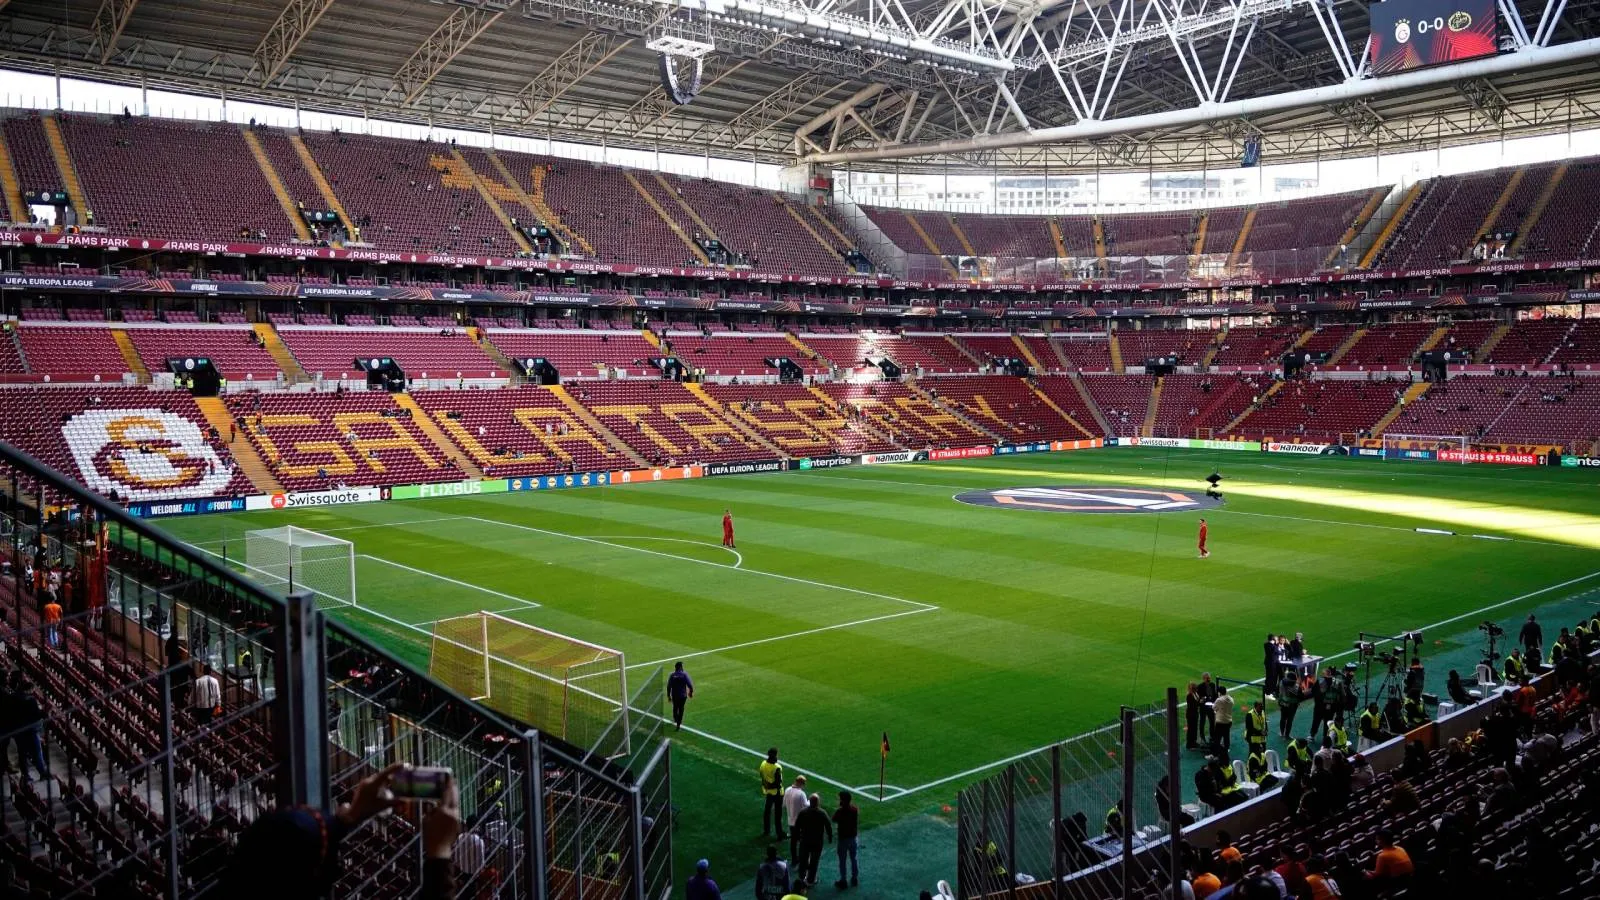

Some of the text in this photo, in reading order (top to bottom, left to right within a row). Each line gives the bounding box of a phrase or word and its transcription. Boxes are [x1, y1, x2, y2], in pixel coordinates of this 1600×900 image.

[1418, 17, 1444, 34] 0-0
[66, 236, 129, 247] RAMS PARK
[171, 242, 228, 252] RAMS PARK
[266, 246, 318, 256] RAMS PARK
[354, 251, 400, 261] RAMS PARK
[434, 256, 478, 265] RAMS PARK
[507, 260, 528, 268] RAMS
[5, 277, 28, 285] UEFA
[29, 278, 61, 286] EUROPA
[1139, 438, 1179, 447] Swissquote
[938, 448, 990, 458] STRAUSS STRAUSS
[1450, 452, 1532, 463] STRAUSS STRAUSS
[801, 456, 852, 468] enterprise
[712, 462, 779, 475] UEFA EUROPA LEAGUE
[420, 482, 481, 498] FLIXBUS
[288, 490, 360, 506] Swissquote
[151, 505, 182, 515] WELCOME
[182, 504, 196, 513] ALL
[208, 500, 244, 511] #FOOTBALL
